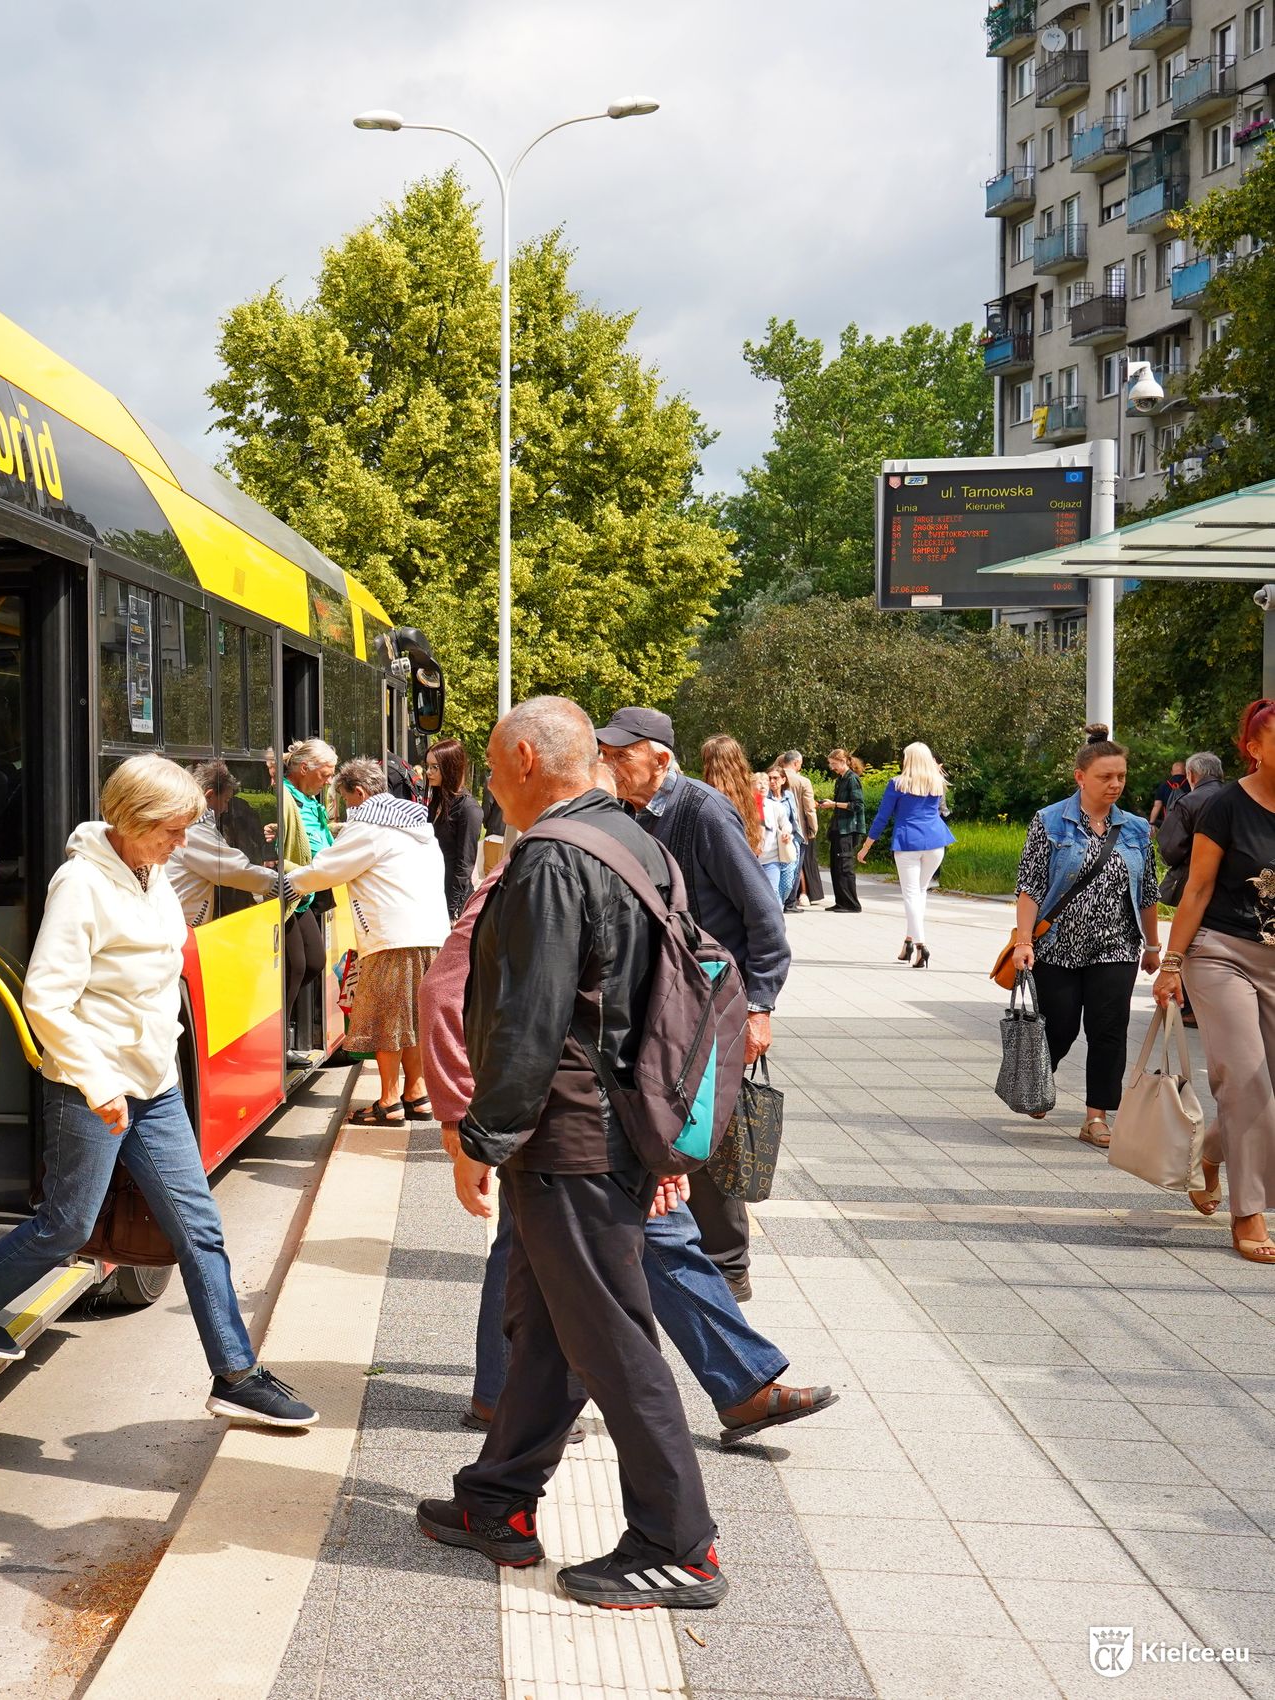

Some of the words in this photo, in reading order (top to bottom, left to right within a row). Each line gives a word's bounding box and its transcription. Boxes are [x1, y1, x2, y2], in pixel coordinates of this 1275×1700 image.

[940, 487, 956, 499] ul.
[961, 485, 1034, 498] Tarnowska
[896, 504, 918, 512] Linia
[965, 502, 1006, 511] Kierunek
[1049, 500, 1082, 509] Odjazd
[892, 524, 902, 532] 28
[912, 546, 940, 554] KAMPUS
